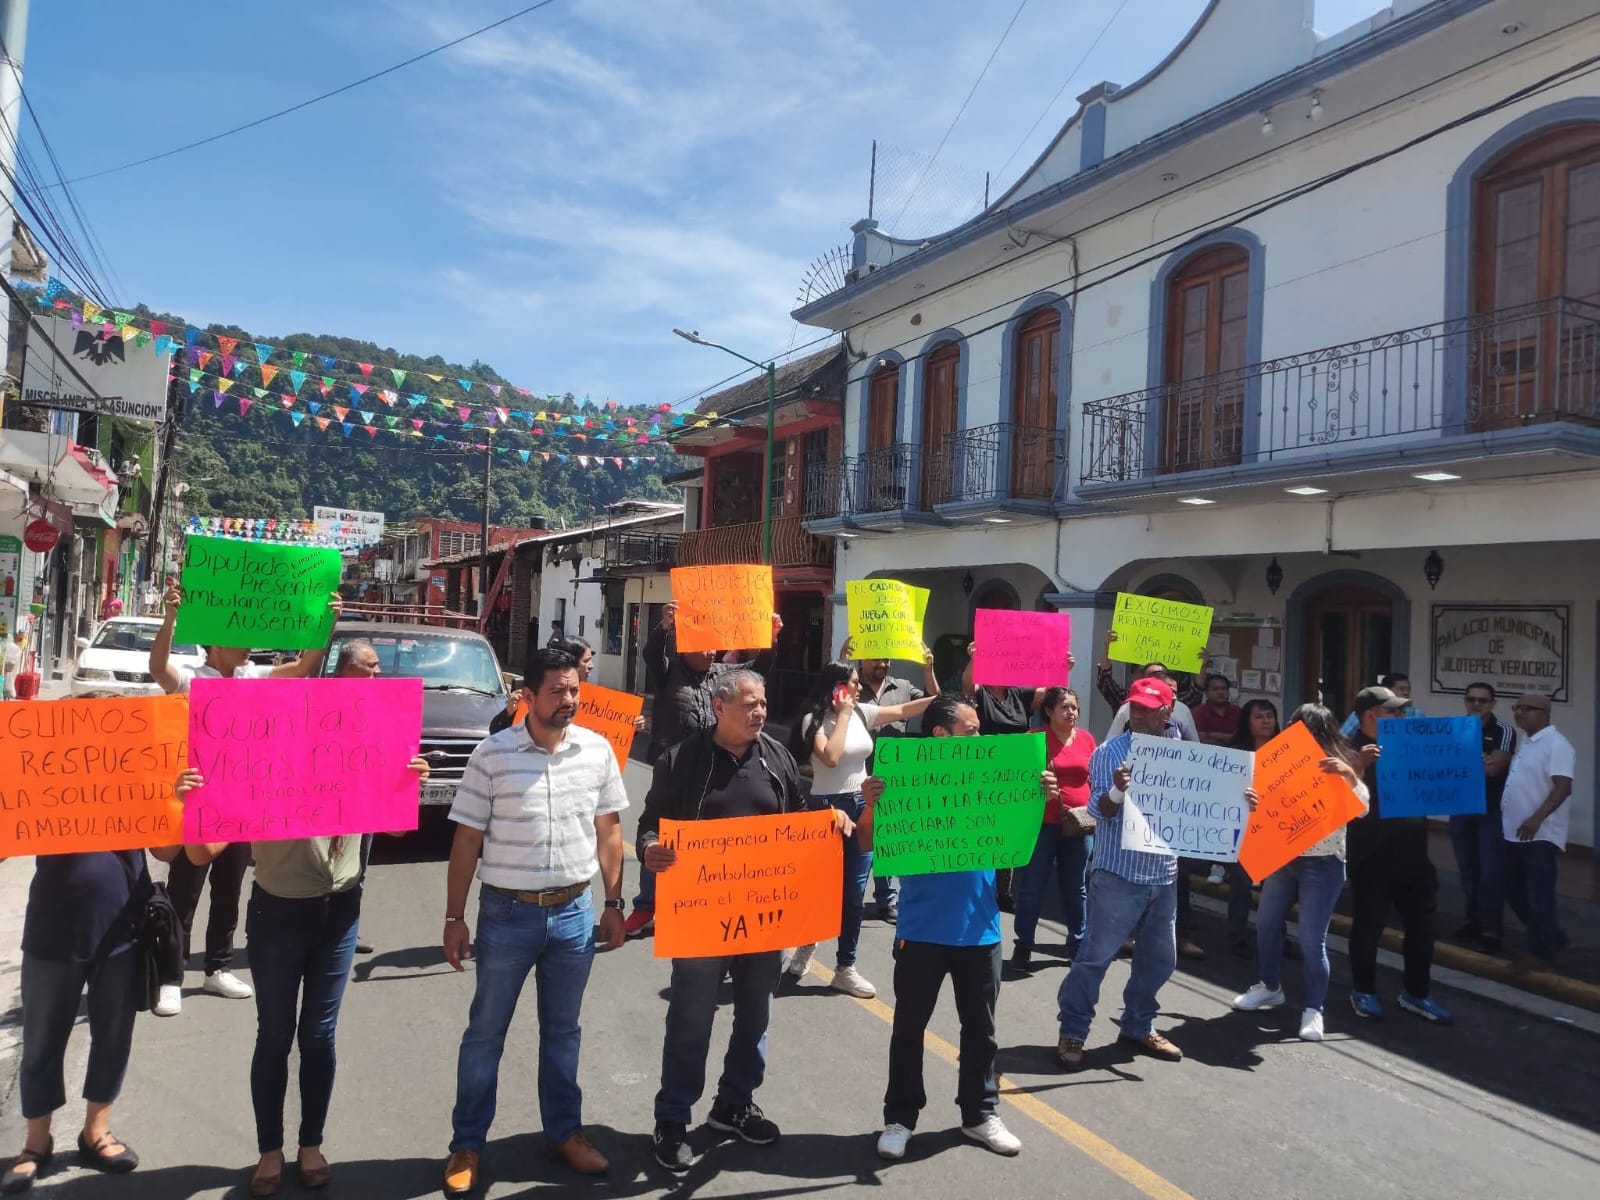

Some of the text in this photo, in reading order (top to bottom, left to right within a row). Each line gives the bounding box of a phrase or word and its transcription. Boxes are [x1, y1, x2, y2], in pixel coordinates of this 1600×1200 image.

[185, 544, 290, 577] Diputado
[240, 574, 324, 597] Presente
[860, 609, 888, 621] JUEGA
[1169, 641, 1182, 651] DE
[1438, 616, 1561, 658] PALACIO MUNICIPAL
[1489, 640, 1504, 655] DE
[20, 741, 188, 777] RESPUESTA
[878, 743, 998, 765] EL ALCALDE
[1180, 778, 1211, 792] una
[1312, 776, 1325, 789] de
[0, 781, 174, 810] LA SOLICITUD
[942, 795, 948, 808] Y
[954, 793, 971, 808] LA
[16, 815, 169, 840] AMBULANCIA
[876, 813, 996, 839] CANDELARIA SON
[875, 835, 1004, 860] INDIFERENTES CON
[929, 851, 1021, 872] JILOTEPEC
[697, 862, 797, 884] Ambulancias
[674, 885, 798, 915] para el Pueblo
